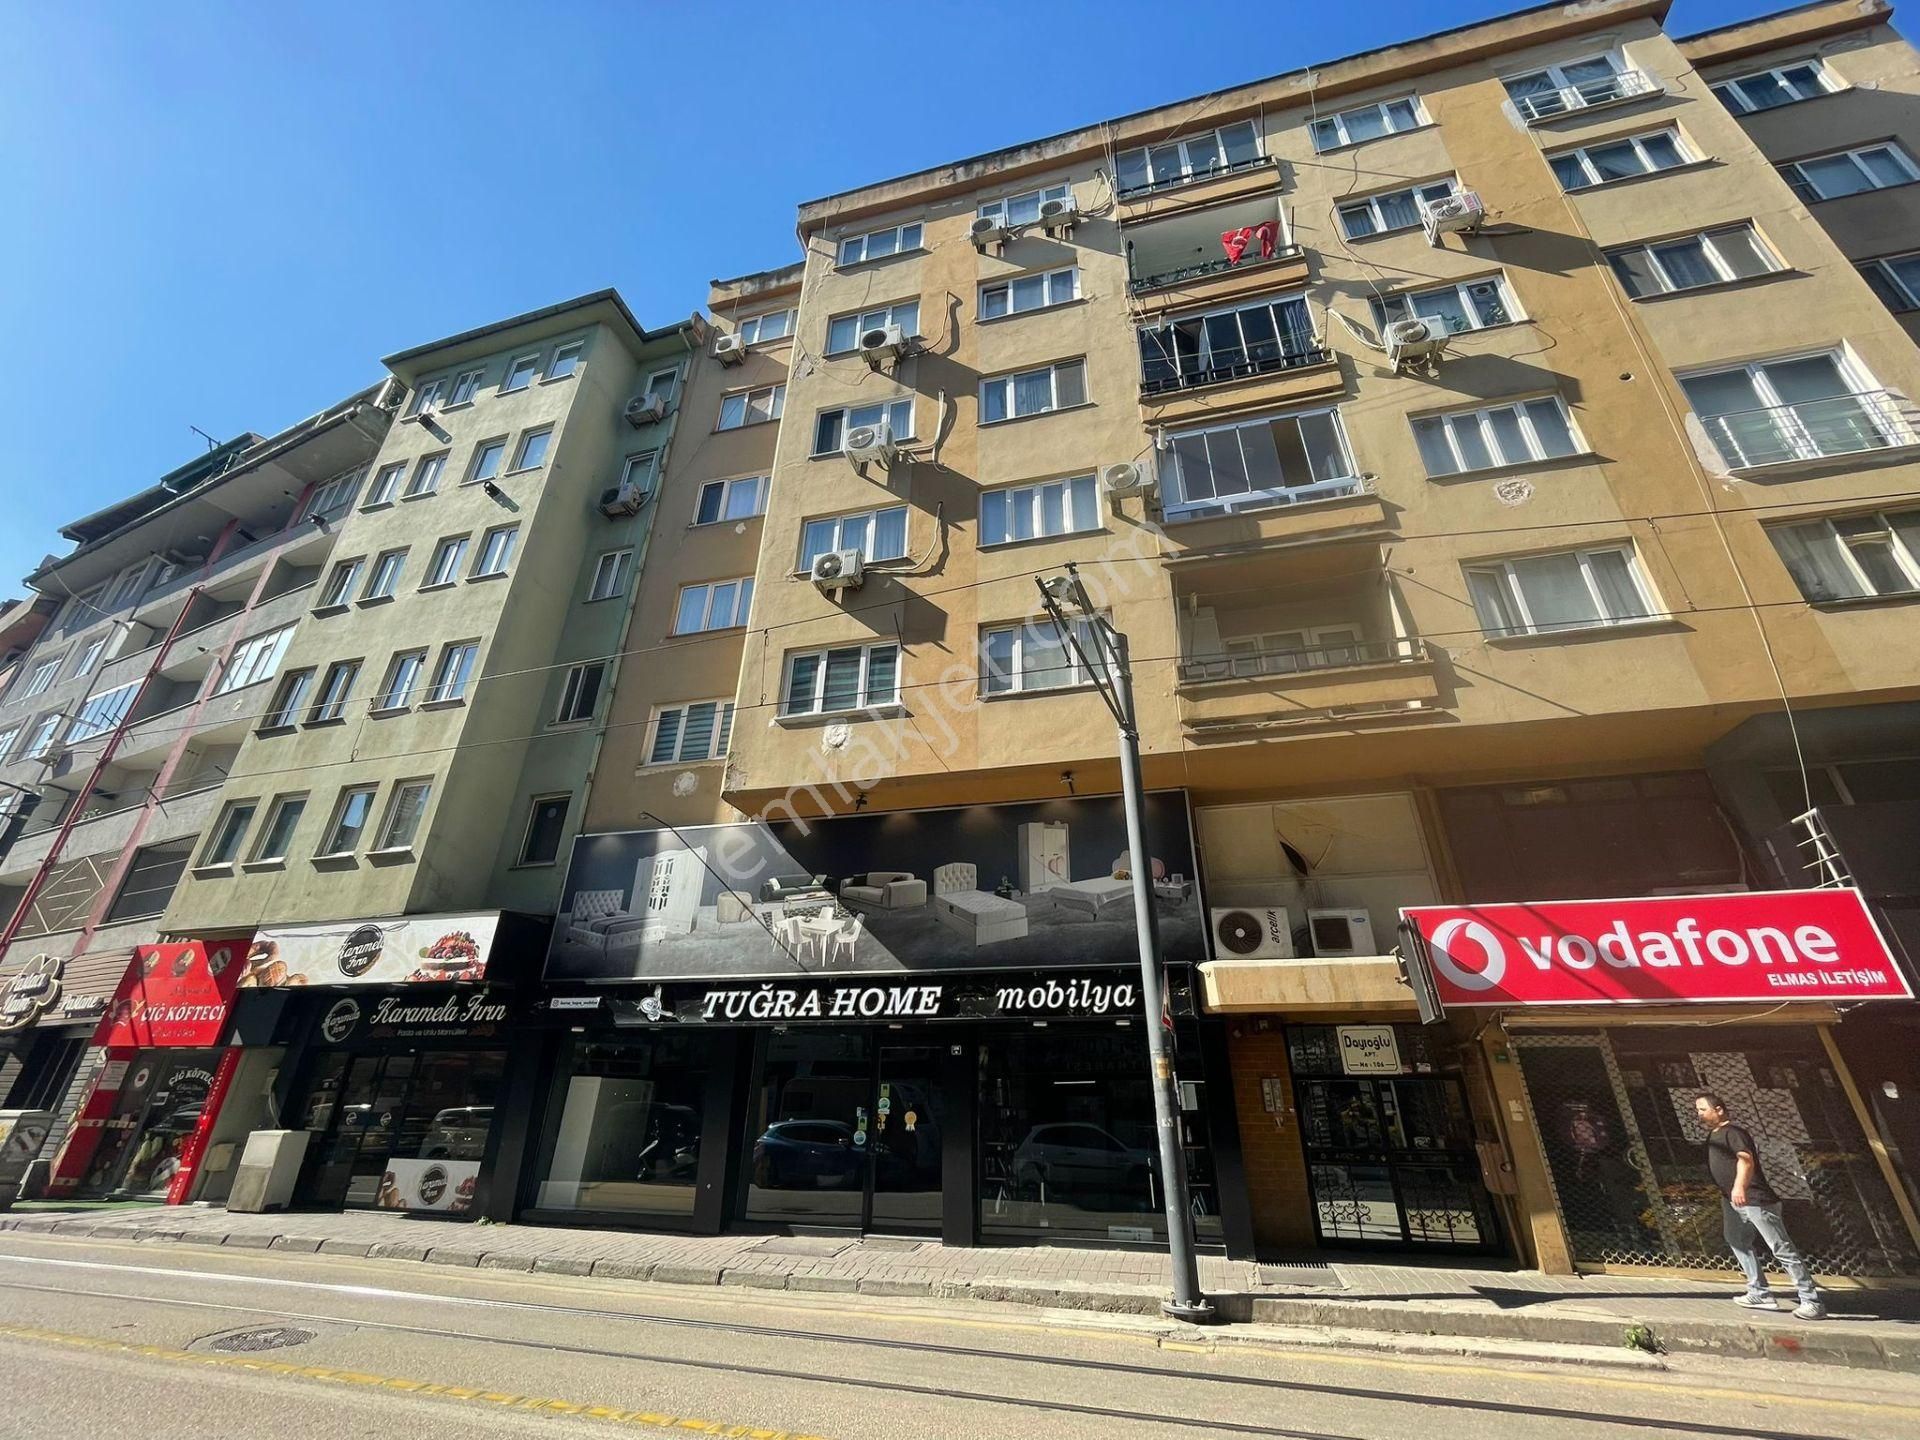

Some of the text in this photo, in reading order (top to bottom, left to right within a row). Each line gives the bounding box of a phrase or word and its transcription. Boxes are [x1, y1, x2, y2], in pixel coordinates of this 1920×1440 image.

[1266, 909, 1281, 944] arçelik
[1518, 917, 1841, 972] vodafone
[1767, 968, 1888, 988] ELMAS İLETİŞİM
[165, 1000, 227, 1022] KÖFTECİ
[370, 994, 507, 1025] Karamela Fırın
[701, 978, 1136, 1019] TUĞRA HOME mobilya
[1343, 1035, 1391, 1050] Dayıoğlu
